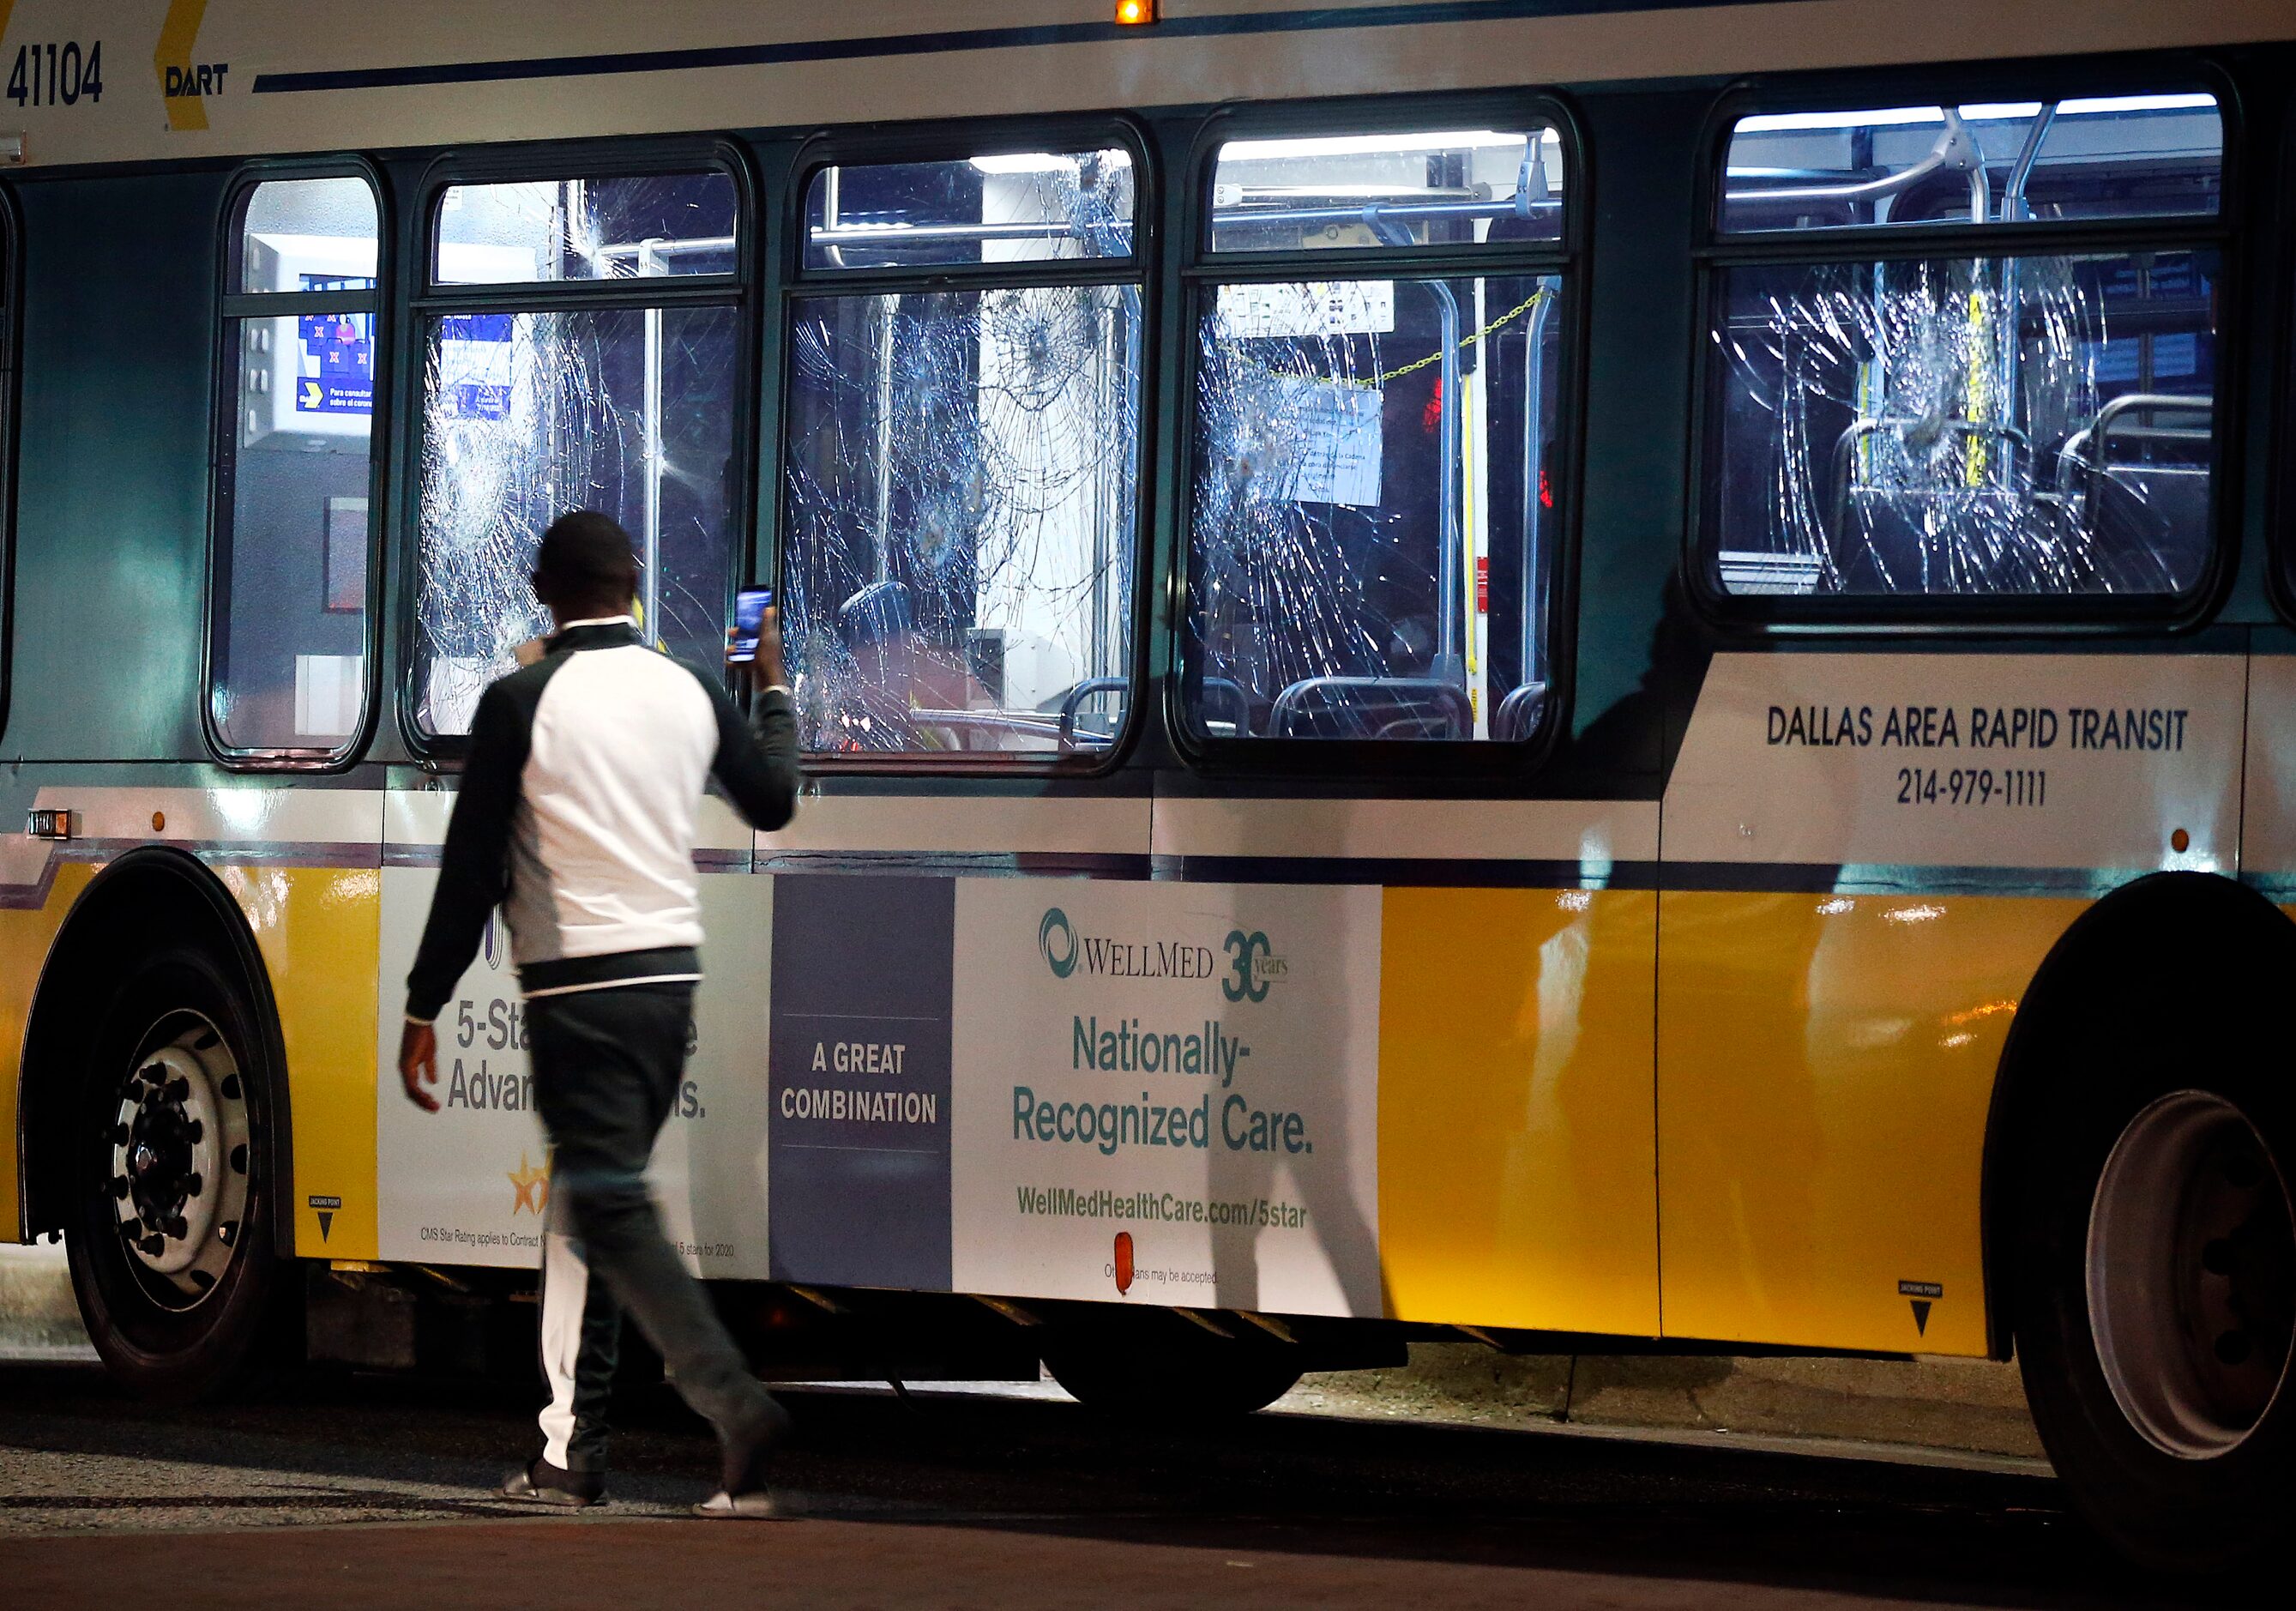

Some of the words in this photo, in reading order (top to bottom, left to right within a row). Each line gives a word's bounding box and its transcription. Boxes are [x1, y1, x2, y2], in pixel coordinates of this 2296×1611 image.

[7, 40, 102, 107] 41104
[166, 63, 229, 97] DART
[329, 388, 344, 397] Para
[329, 398, 347, 407] sobre
[1767, 706, 1872, 746] DALLAS
[1881, 707, 1959, 747] AREA
[1971, 708, 2058, 748] RAPID
[2068, 709, 2189, 751] TRANSIT
[1897, 769, 2046, 806] 214-979-1111
[457, 999, 533, 1051] 5-Sta
[811, 1042, 827, 1071] A
[833, 1041, 906, 1074] GREAT
[1072, 1015, 1250, 1089] Nationally-
[780, 1088, 937, 1124] COMBINATION
[1013, 1086, 1209, 1155] Recognized
[1221, 1094, 1313, 1154] Care.
[1017, 1186, 1307, 1229] WellMedHealthCare.com/5star
[420, 1227, 438, 1241] CMS
[439, 1228, 454, 1242] Star
[455, 1228, 476, 1246] Rating
[477, 1232, 500, 1248] applies
[502, 1234, 509, 1246] to
[509, 1232, 539, 1247] Contract
[686, 1244, 702, 1256] stars
[704, 1242, 714, 1256] for
[1151, 1270, 1167, 1285] may
[1169, 1267, 1179, 1282] be
